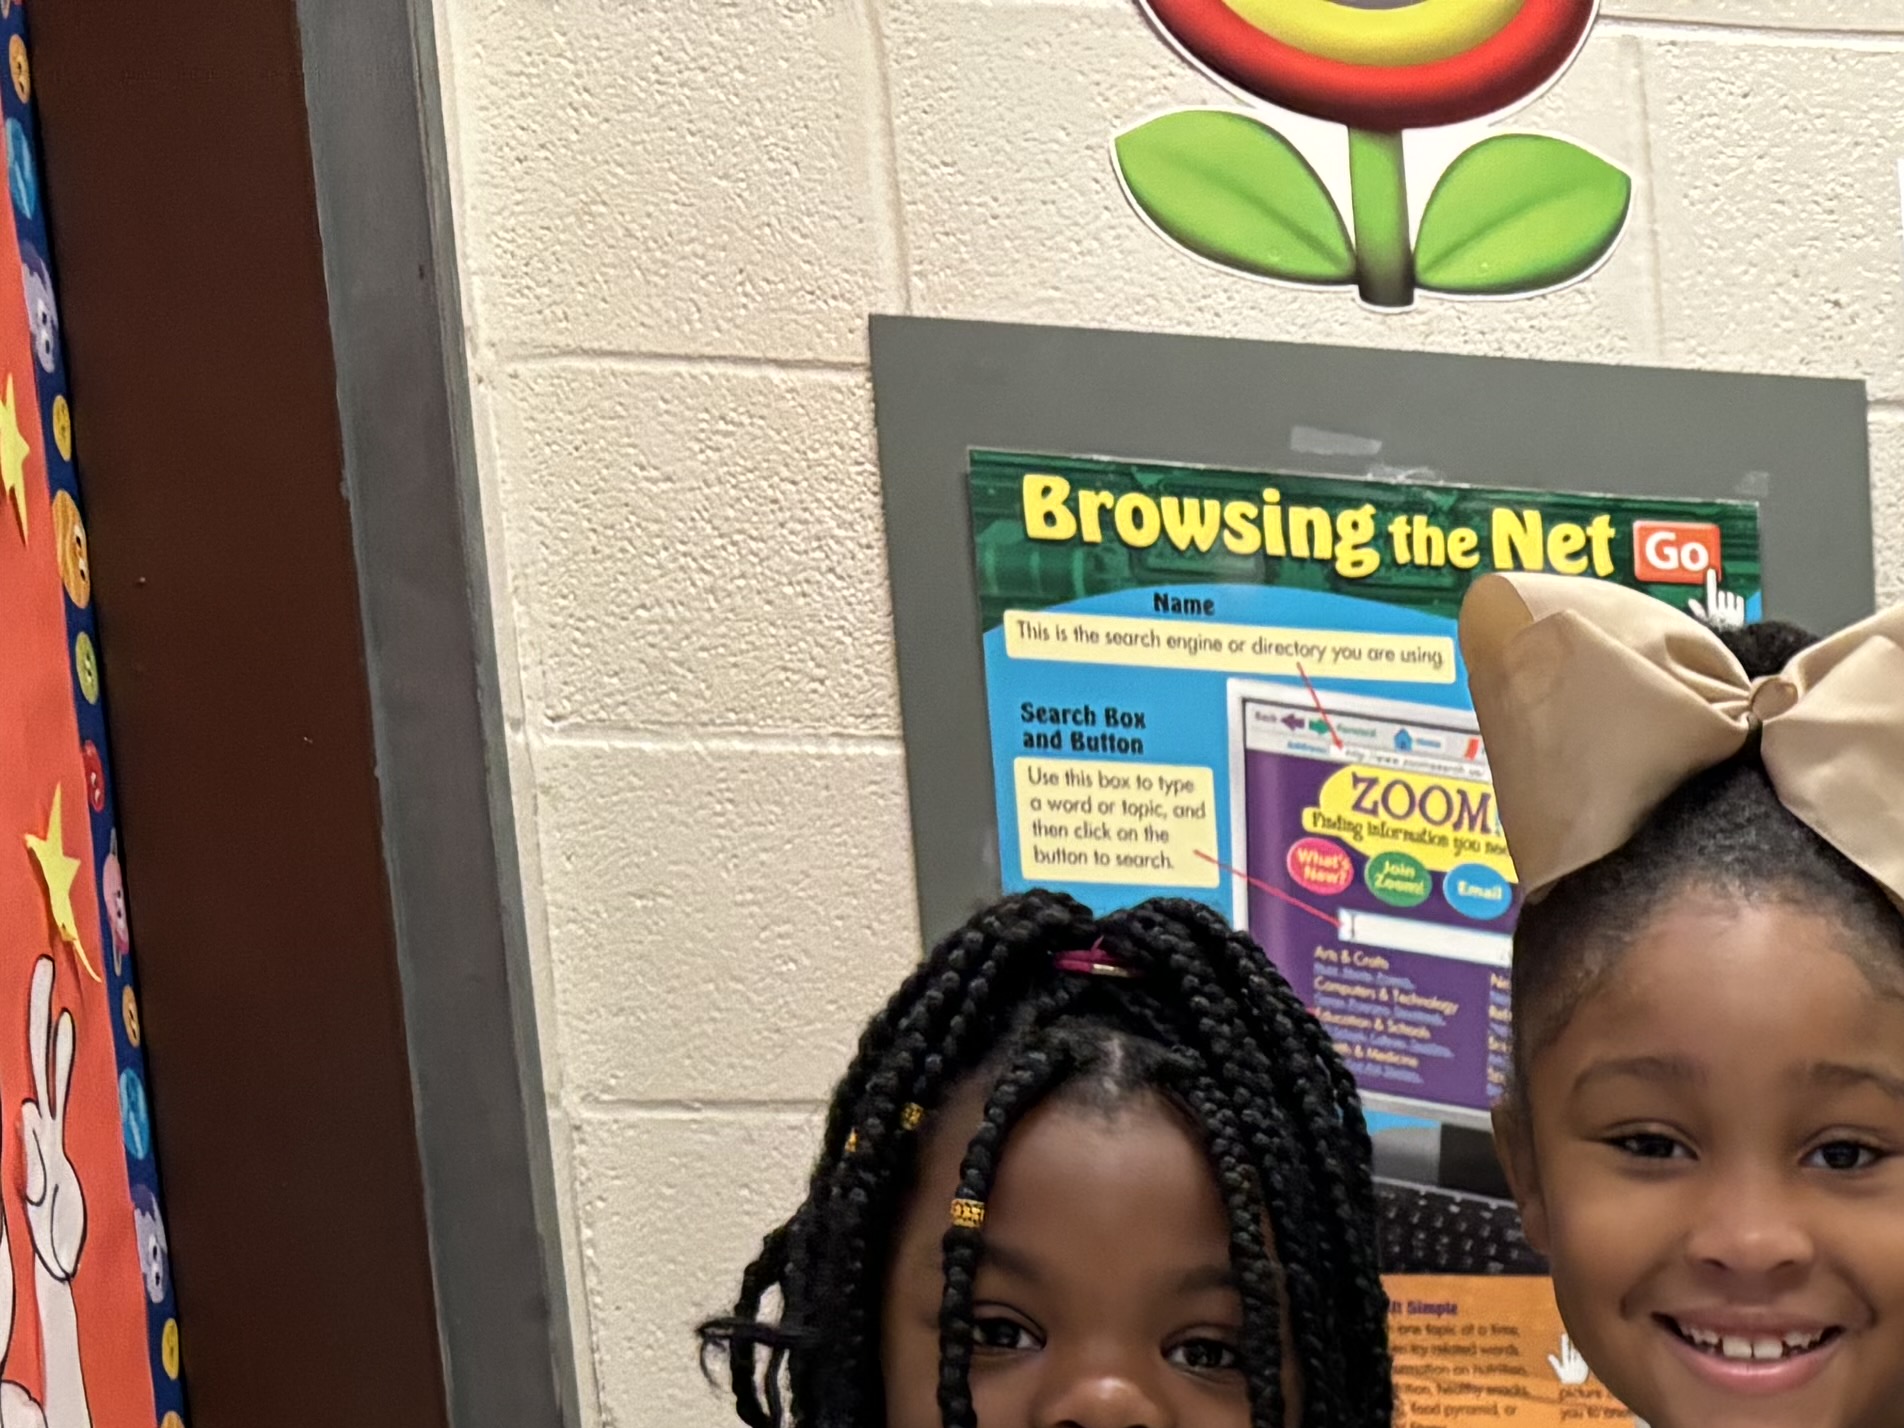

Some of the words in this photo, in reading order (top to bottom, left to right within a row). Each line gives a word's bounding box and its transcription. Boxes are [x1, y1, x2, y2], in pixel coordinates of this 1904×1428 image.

[1022, 473, 1380, 578] Browsing
[1388, 514, 1480, 569] the
[1492, 507, 1616, 577] Net
[1645, 531, 1709, 571] Go
[1153, 592, 1215, 616] Name
[1017, 620, 1050, 641] This
[1056, 623, 1067, 642] is
[1073, 624, 1099, 645] the
[1105, 628, 1160, 650] search
[1167, 633, 1222, 656] engine
[1229, 637, 1246, 653] or
[1252, 635, 1326, 662] directory
[1332, 646, 1362, 665] you
[1368, 648, 1395, 663] are
[1021, 702, 1096, 727] Search
[1104, 706, 1146, 729] Box
[1023, 730, 1062, 750] and
[1070, 731, 1144, 755] Button
[1028, 765, 1059, 785] Use
[1065, 769, 1093, 788] this
[1099, 770, 1130, 789] box
[1136, 774, 1153, 791] to
[1159, 775, 1194, 797] type
[1030, 797, 1041, 811] a
[1047, 796, 1091, 815] word
[1098, 801, 1115, 815] or
[1122, 799, 1167, 821] topic,
[1173, 801, 1206, 819] and
[1033, 820, 1068, 838] then
[1074, 820, 1110, 841] click
[1117, 829, 1138, 842] on
[1144, 825, 1169, 843] the
[1312, 811, 1363, 841] Finding
[1366, 819, 1449, 847] information
[1453, 836, 1481, 857] you
[1034, 845, 1087, 865] button
[1094, 849, 1110, 866] to
[1116, 851, 1174, 870] search.
[1297, 847, 1350, 869] What's
[1382, 860, 1415, 877] Join
[1457, 881, 1503, 901] Email
[1407, 1301, 1458, 1318] Simple
